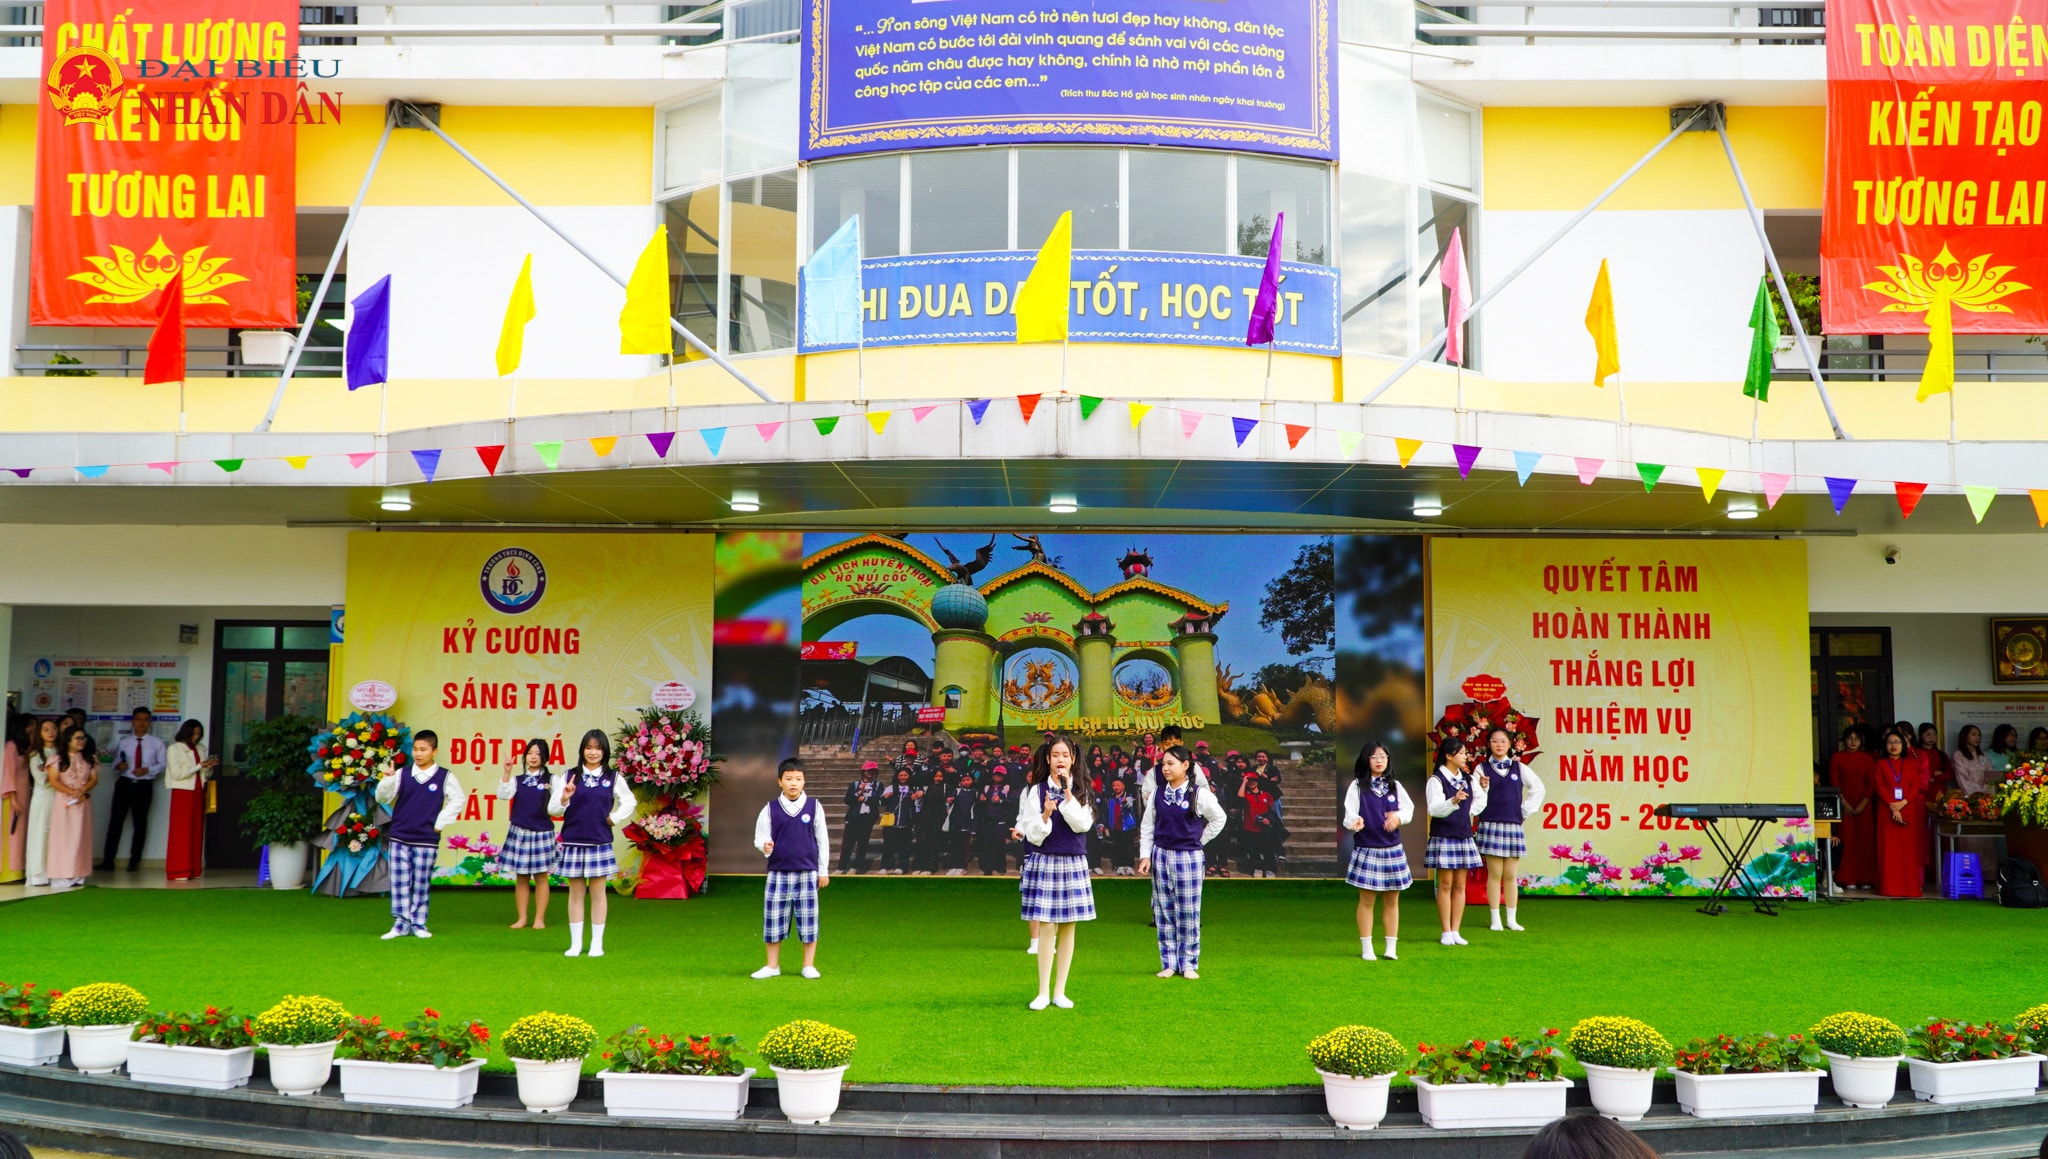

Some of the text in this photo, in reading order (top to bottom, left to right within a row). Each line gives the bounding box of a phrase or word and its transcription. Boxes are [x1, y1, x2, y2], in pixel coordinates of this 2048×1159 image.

[56, 8, 286, 74] CHẤT LƯỢNG
[855, 8, 1285, 39] “... Non sông Việt Nam có trở nên tươi đẹp hay không, dân tộc
[855, 30, 1285, 62] Việt Nam có bước tới đài vinh quang để sánh vai với các cường
[1855, 15, 2048, 77] TOÀN DIỆN
[855, 53, 1286, 80] quốc năm châu được hay không, chính là nhờ một phần lớn ở
[855, 75, 1049, 99] công học tập của các em...”
[1868, 86, 2043, 156] KIẾN TẠO
[68, 170, 265, 219] TƯƠNG LAI
[1853, 175, 2047, 226] TƯƠNG LAI
[862, 287, 888, 322] HI
[898, 283, 973, 319] ĐUA
[1070, 265, 1149, 321] TỐT,
[1161, 282, 1232, 330] HỌC
[1543, 556, 1698, 595] QUYẾT TÂM
[443, 618, 580, 655] KỶ CƯƠNG
[1532, 607, 1711, 639] HOÀN THÀNH
[1549, 650, 1695, 693] THẮNG LỢI
[442, 677, 578, 716] SÁNG TẠO
[1037, 717, 1059, 731] DU
[1555, 702, 1692, 741] NHIỆM VỤ
[450, 732, 566, 771] ĐỘT PÁ
[1559, 749, 1689, 788] NĂM HỌC
[1543, 803, 1611, 830] 2025
